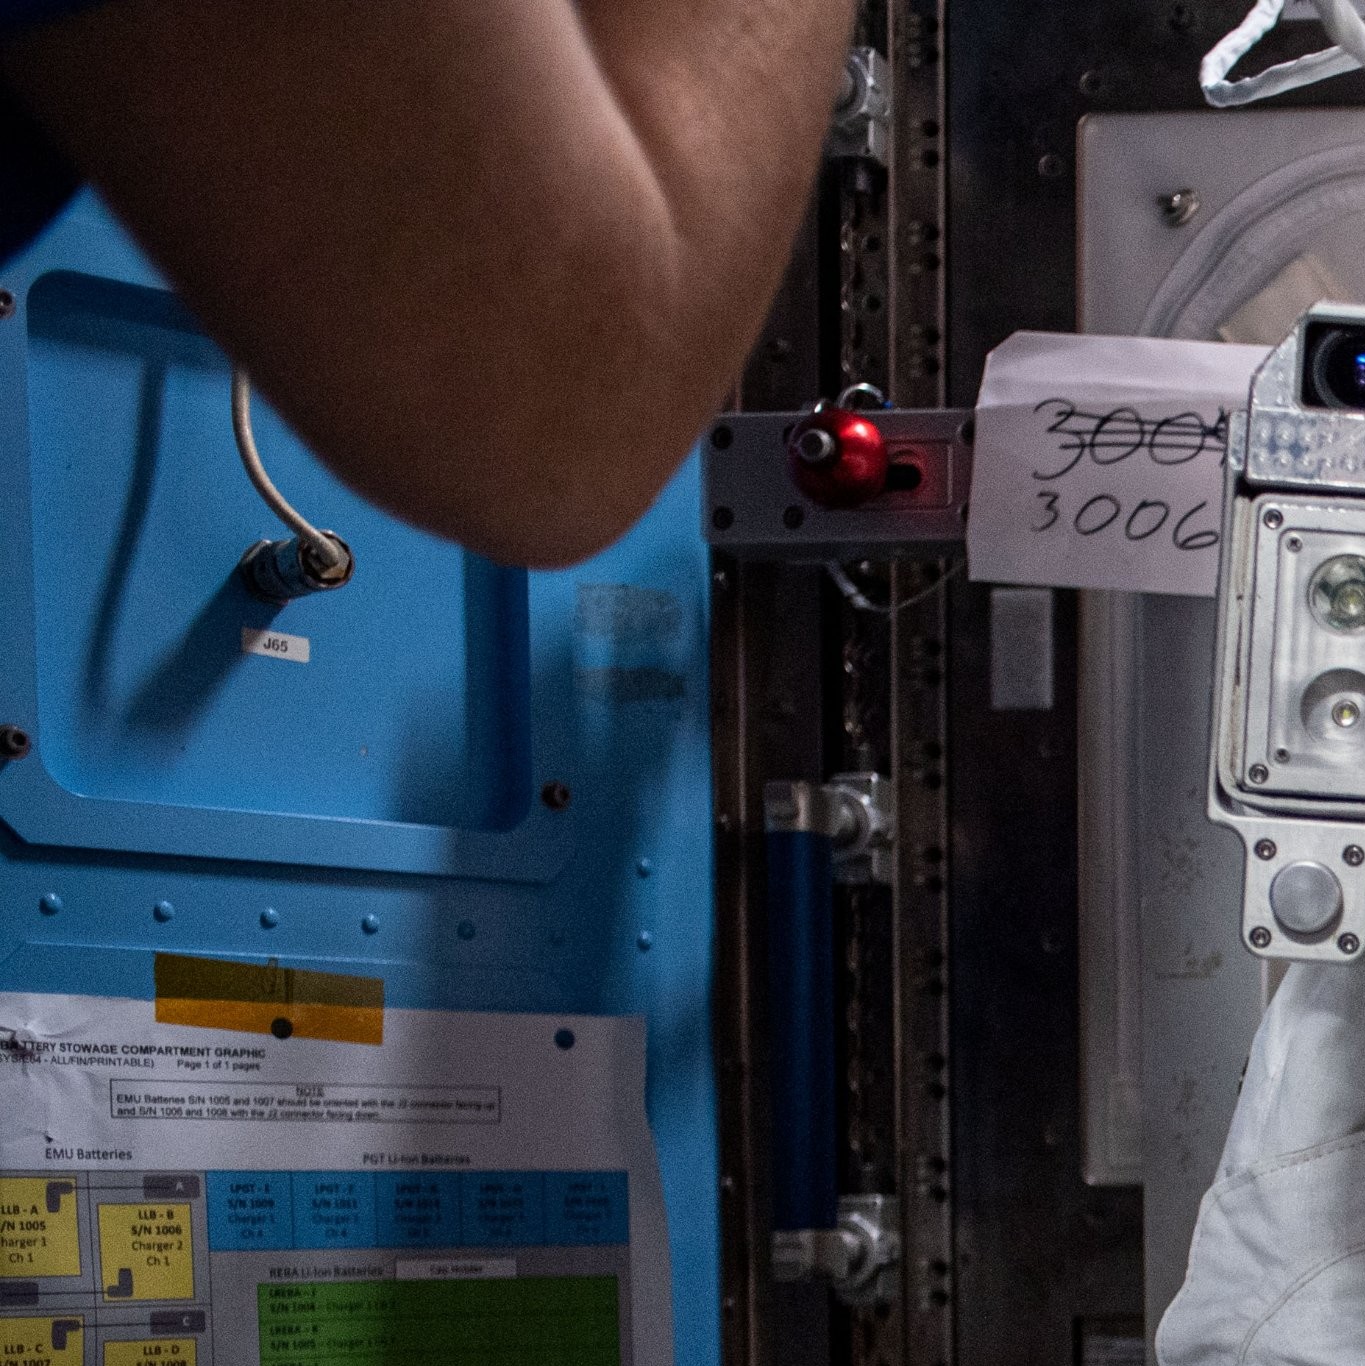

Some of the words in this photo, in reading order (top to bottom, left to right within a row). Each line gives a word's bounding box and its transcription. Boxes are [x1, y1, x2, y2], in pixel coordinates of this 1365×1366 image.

[1032, 492, 1220, 550] 3006
[264, 638, 288, 652] J65
[59, 1042, 118, 1054] STOWAGE
[121, 1044, 210, 1057] COMPARTMENT
[214, 1047, 266, 1058] GRAPHIC
[177, 1059, 201, 1070] Page
[204, 1060, 210, 1068] 1
[212, 1060, 222, 1068] of
[224, 1060, 230, 1069] 1
[232, 1062, 260, 1072] pages
[116, 1094, 142, 1104] EMU
[144, 1094, 186, 1106] Batteries
[188, 1096, 206, 1106] S/N
[233, 1096, 250, 1106] and
[117, 1106, 136, 1116] and
[138, 1106, 157, 1116] S/N
[185, 1108, 202, 1118] and
[230, 1108, 248, 1118] with
[44, 1148, 74, 1160] EMU
[76, 1149, 132, 1161] Batteries
[30, 1206, 39, 1215] A
[138, 1210, 156, 1220] LLB
[166, 1210, 174, 1220] B
[0, 1221, 16, 1232] /N
[19, 1220, 46, 1232] 1005
[130, 1225, 152, 1236] S/N
[155, 1225, 182, 1236] 1006
[0, 1236, 39, 1248] harger
[41, 1236, 47, 1246] 1
[131, 1240, 173, 1252] Charger
[176, 1240, 183, 1250] 2
[8, 1252, 24, 1264] Ch
[28, 1252, 34, 1263] 1
[146, 1256, 162, 1266] Ch
[164, 1256, 170, 1266] 1
[182, 1317, 190, 1326] C
[4, 1344, 24, 1354] LLB
[35, 1344, 44, 1354] C
[142, 1345, 161, 1356] LLB
[172, 1344, 180, 1355] D
